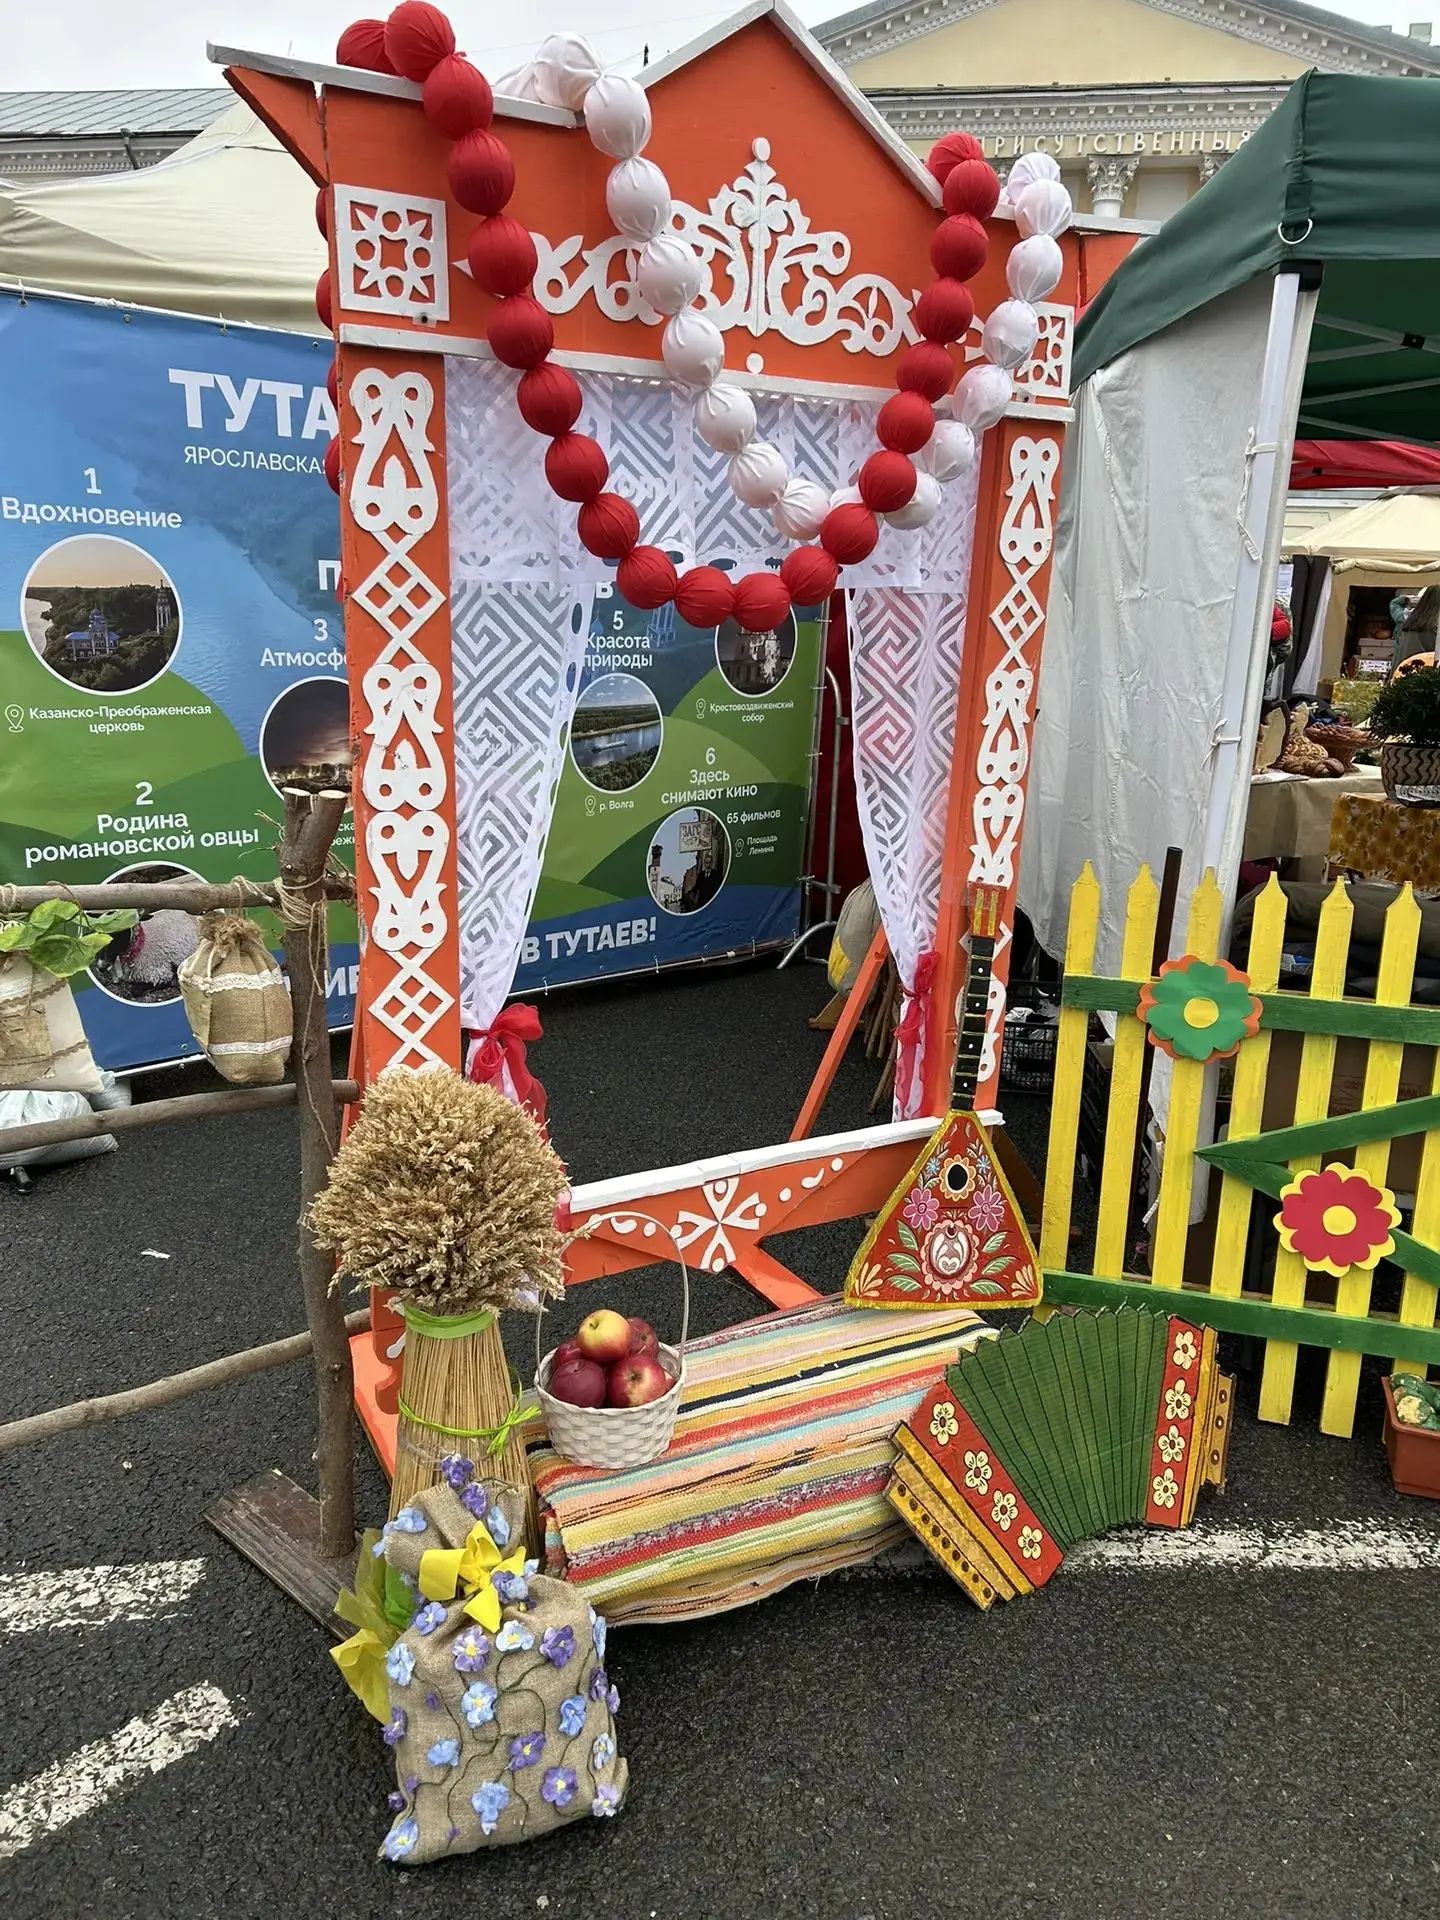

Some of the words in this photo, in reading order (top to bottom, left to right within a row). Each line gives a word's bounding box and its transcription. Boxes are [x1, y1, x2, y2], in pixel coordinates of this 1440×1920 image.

[184, 446, 326, 475] ЯРОСЛАВСКА
[84, 467, 102, 495] 1
[1, 496, 183, 528] Вдохновение
[313, 618, 328, 641] 3
[612, 610, 624, 631] 5
[587, 632, 651, 652] Красота
[260, 647, 347, 671] Атмосф
[584, 654, 653, 671] природы
[29, 704, 212, 720] Казанско-Преображенская
[709, 700, 794, 714] Крестовоздвиженский
[741, 713, 765, 723] собор
[89, 722, 145, 735] церковь
[705, 747, 716, 765] 6
[689, 768, 731, 786] Здесь
[135, 781, 154, 806] 2
[661, 788, 723, 805] снимают
[726, 785, 758, 799] кино
[609, 800, 635, 811] Волга
[97, 812, 189, 834] Родина
[726, 812, 738, 824] 65
[740, 809, 781, 825] фильмов
[25, 830, 195, 868] романовской
[200, 829, 260, 848] овцы
[747, 836, 778, 846] Площадь
[749, 846, 775, 856] Ленина
[521, 936, 541, 965] В
[546, 916, 657, 960] ТУТАЕВ!
